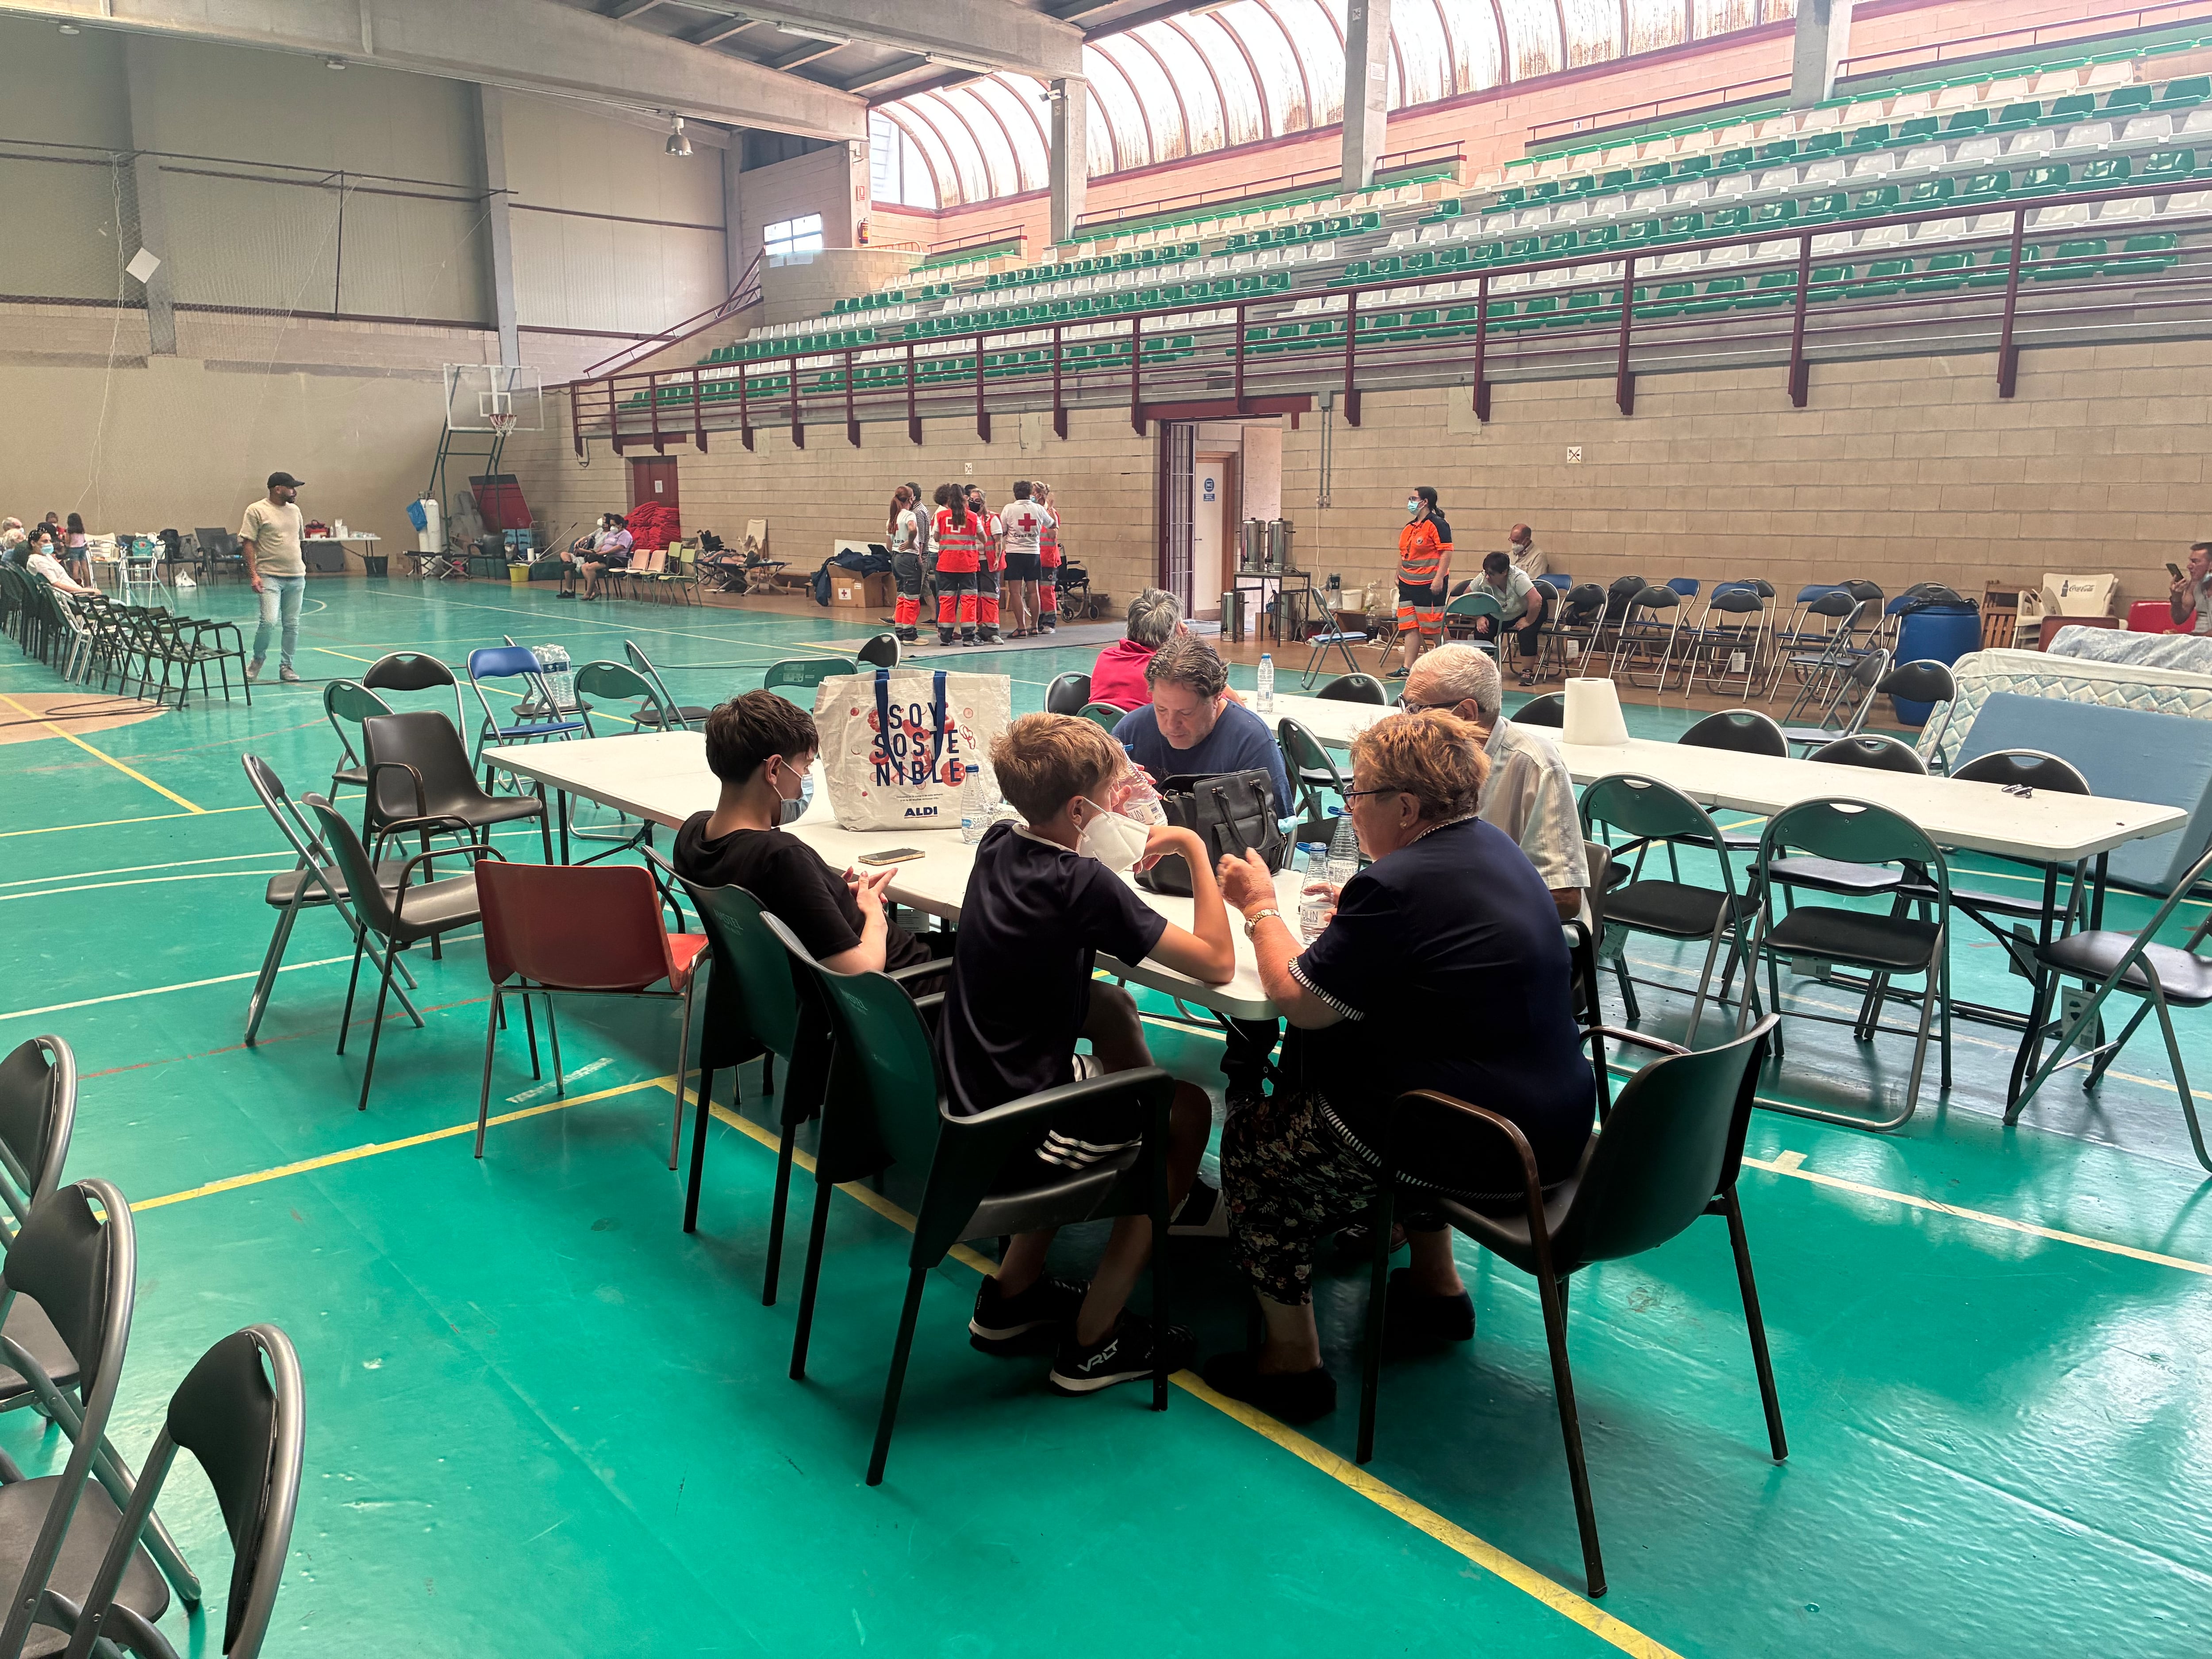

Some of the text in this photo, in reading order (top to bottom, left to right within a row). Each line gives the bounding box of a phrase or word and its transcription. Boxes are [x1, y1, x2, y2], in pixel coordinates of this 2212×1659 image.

[889, 702, 937, 729] SOY
[876, 757, 961, 787] NIBLE
[904, 806, 938, 817] ALDI
